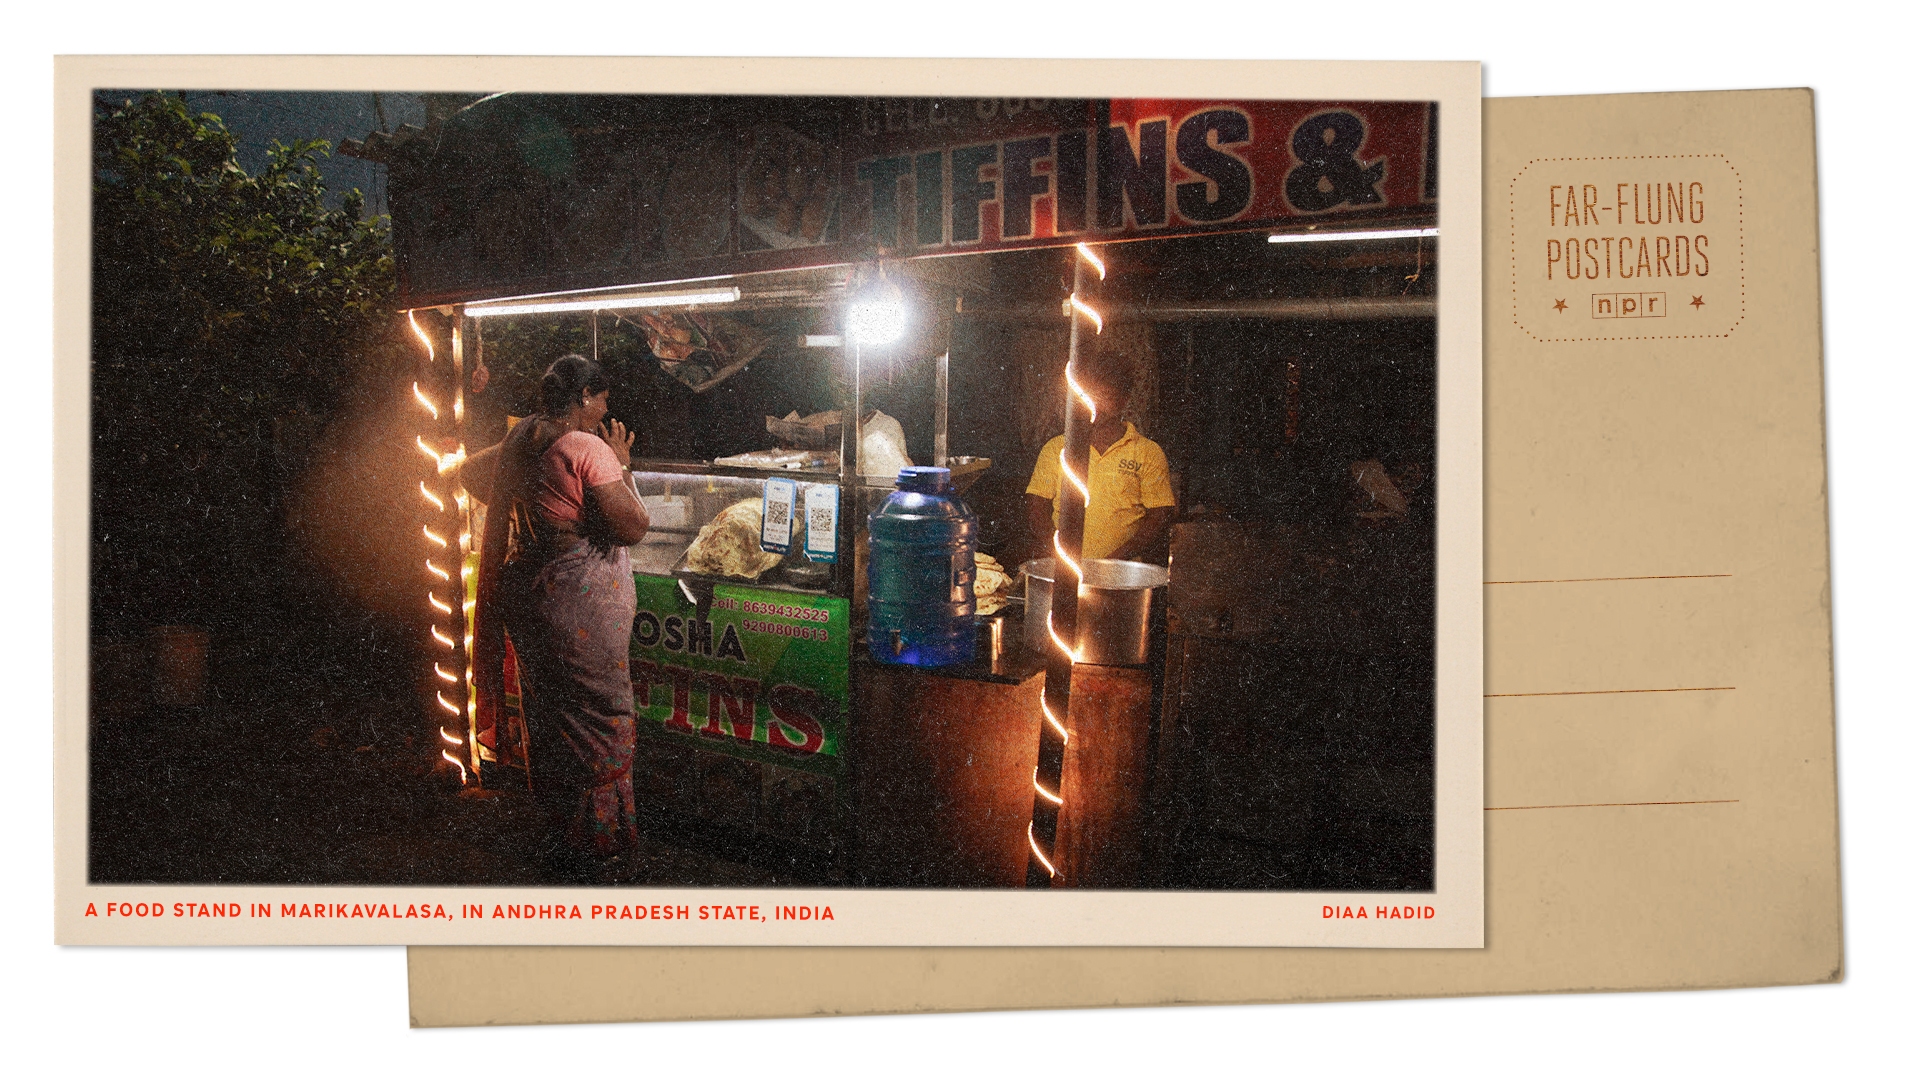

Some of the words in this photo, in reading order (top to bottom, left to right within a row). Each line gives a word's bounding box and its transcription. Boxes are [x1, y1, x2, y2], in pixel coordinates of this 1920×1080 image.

[856, 105, 1256, 249] TIFFINS
[1283, 108, 1389, 213] &
[743, 600, 829, 623] 8639432525
[742, 619, 828, 642] 9290800613
